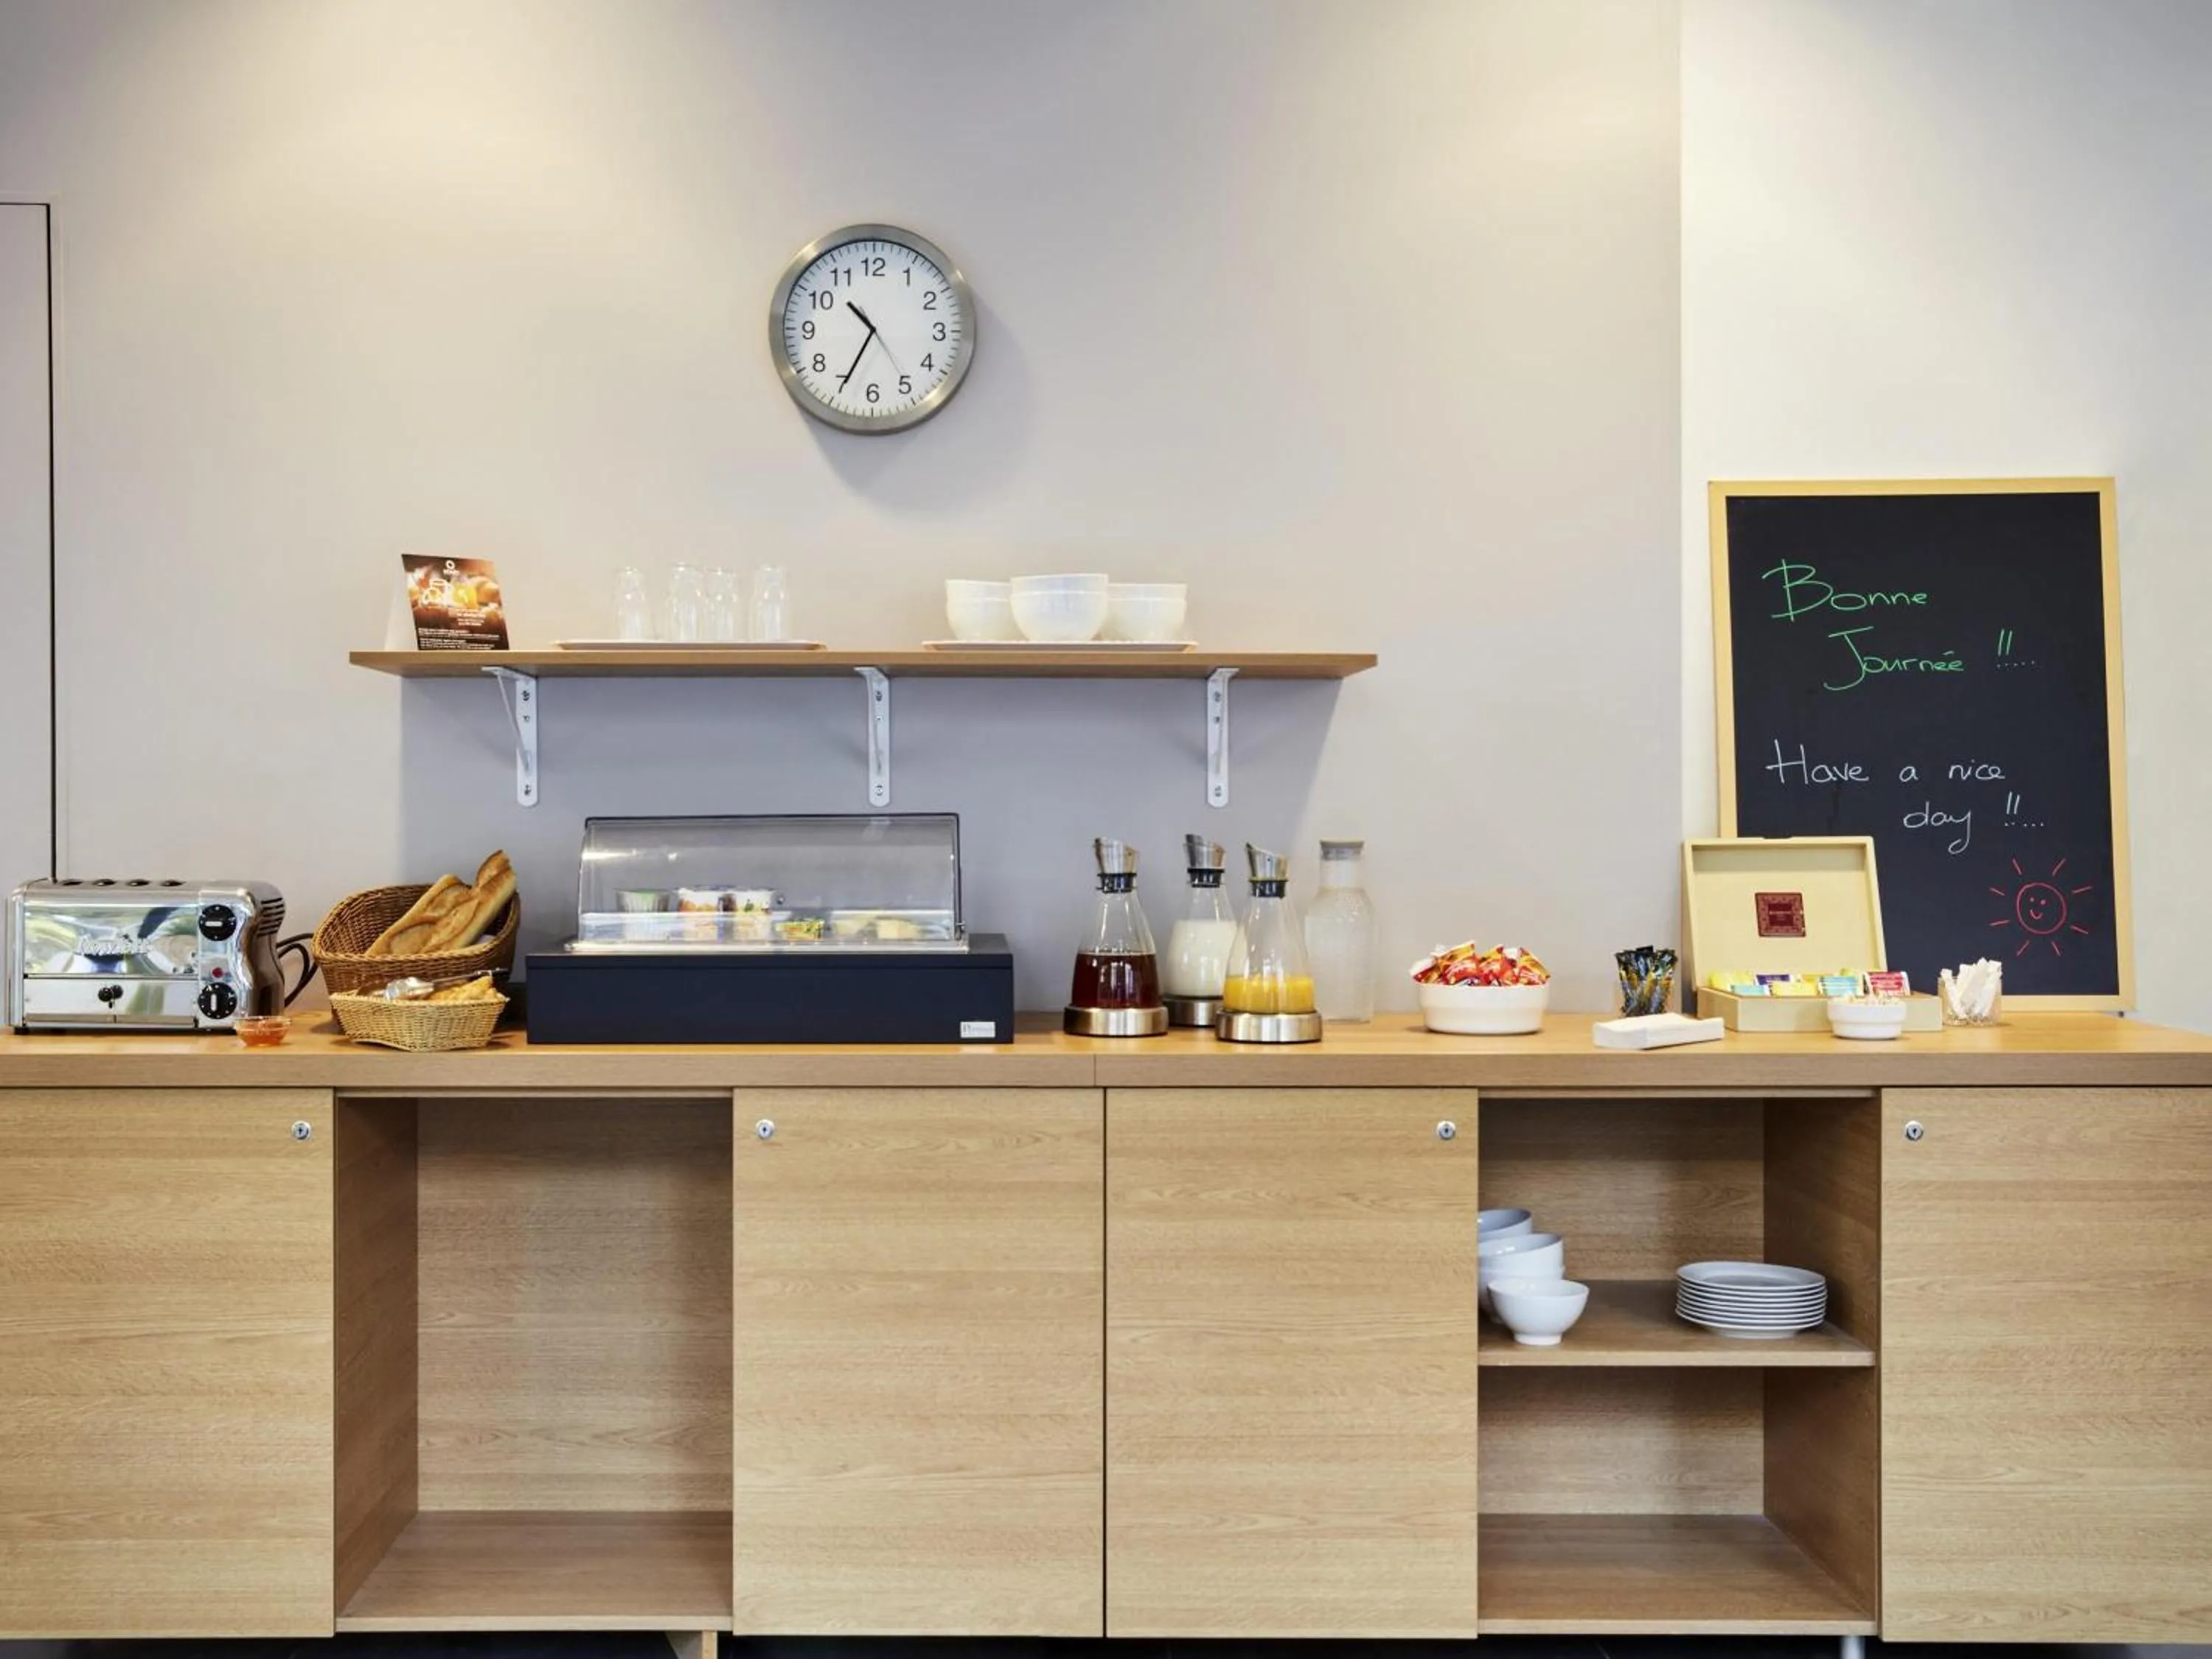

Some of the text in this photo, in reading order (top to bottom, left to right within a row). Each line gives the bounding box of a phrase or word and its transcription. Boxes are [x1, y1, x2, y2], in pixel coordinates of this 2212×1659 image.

[860, 257, 886, 276] 12
[830, 268, 852, 286] 11
[902, 267, 911, 287] 1
[808, 290, 834, 310] 10
[922, 291, 937, 310] 2
[801, 321, 815, 339] 9
[932, 322, 947, 341] 3
[812, 354, 827, 372] 8
[919, 353, 934, 372] 4
[835, 375, 849, 394] 7
[866, 383, 880, 403] 6
[898, 375, 912, 394] 5
[1761, 559, 1927, 622] Bonne
[1823, 626, 1964, 690] Journée
[1765, 739, 2005, 785] Have a nice
[1903, 801, 1971, 855] day
